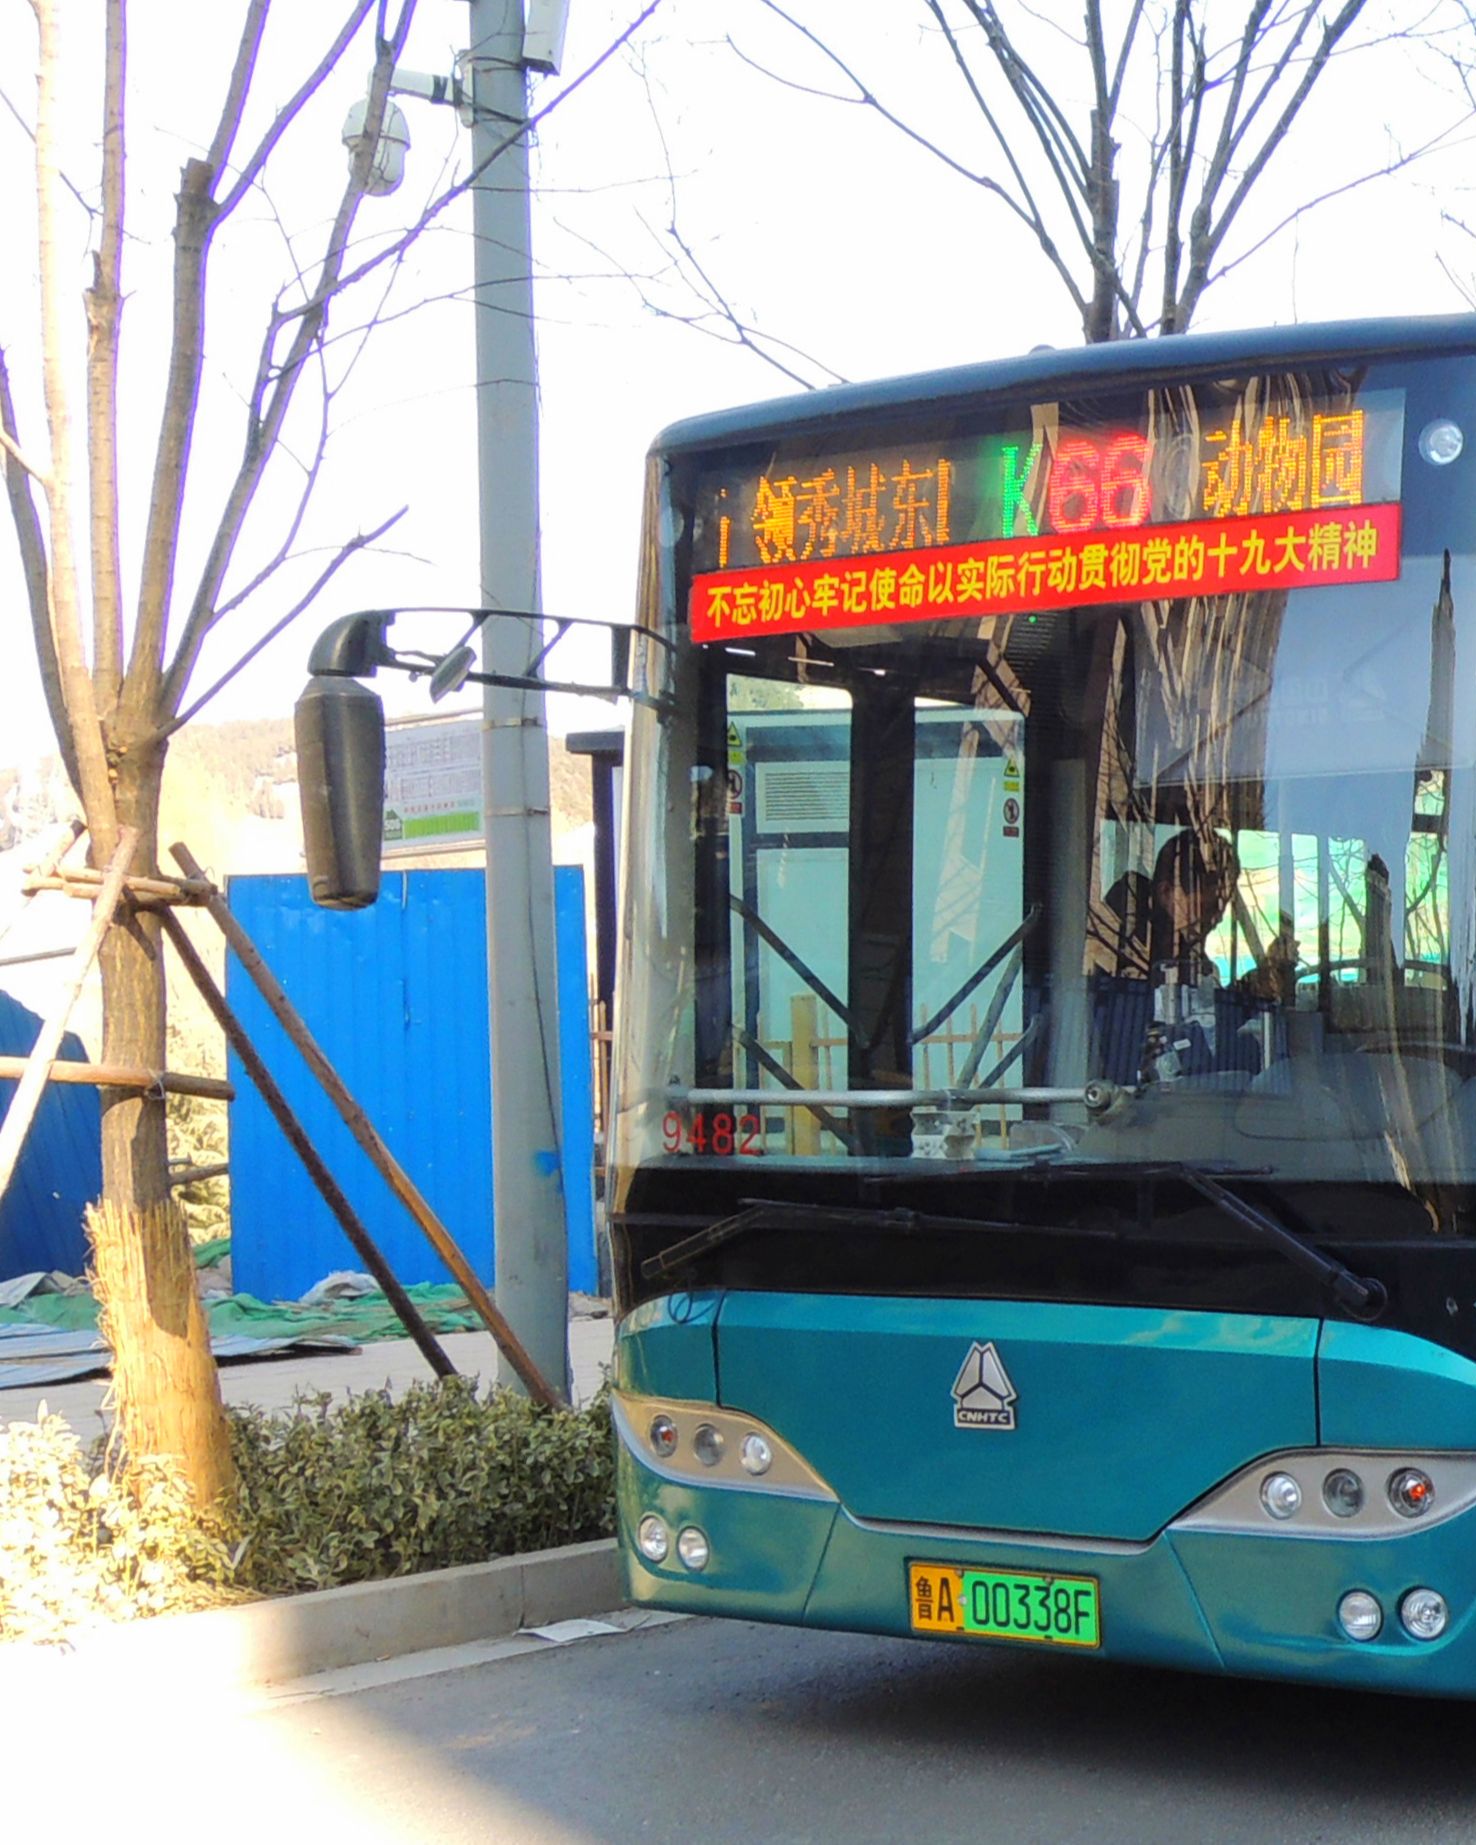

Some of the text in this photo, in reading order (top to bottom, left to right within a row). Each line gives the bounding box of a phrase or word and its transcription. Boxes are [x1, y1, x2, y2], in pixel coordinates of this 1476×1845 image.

[1001, 431, 1152, 538] K66
[1202, 410, 1364, 520] 动物园
[706, 521, 1377, 628] 不忘初心牢记使命以实际行动贯彻党的十九大精神
[662, 1110, 761, 1155] 9482
[957, 1410, 1008, 1424] CNHTC
